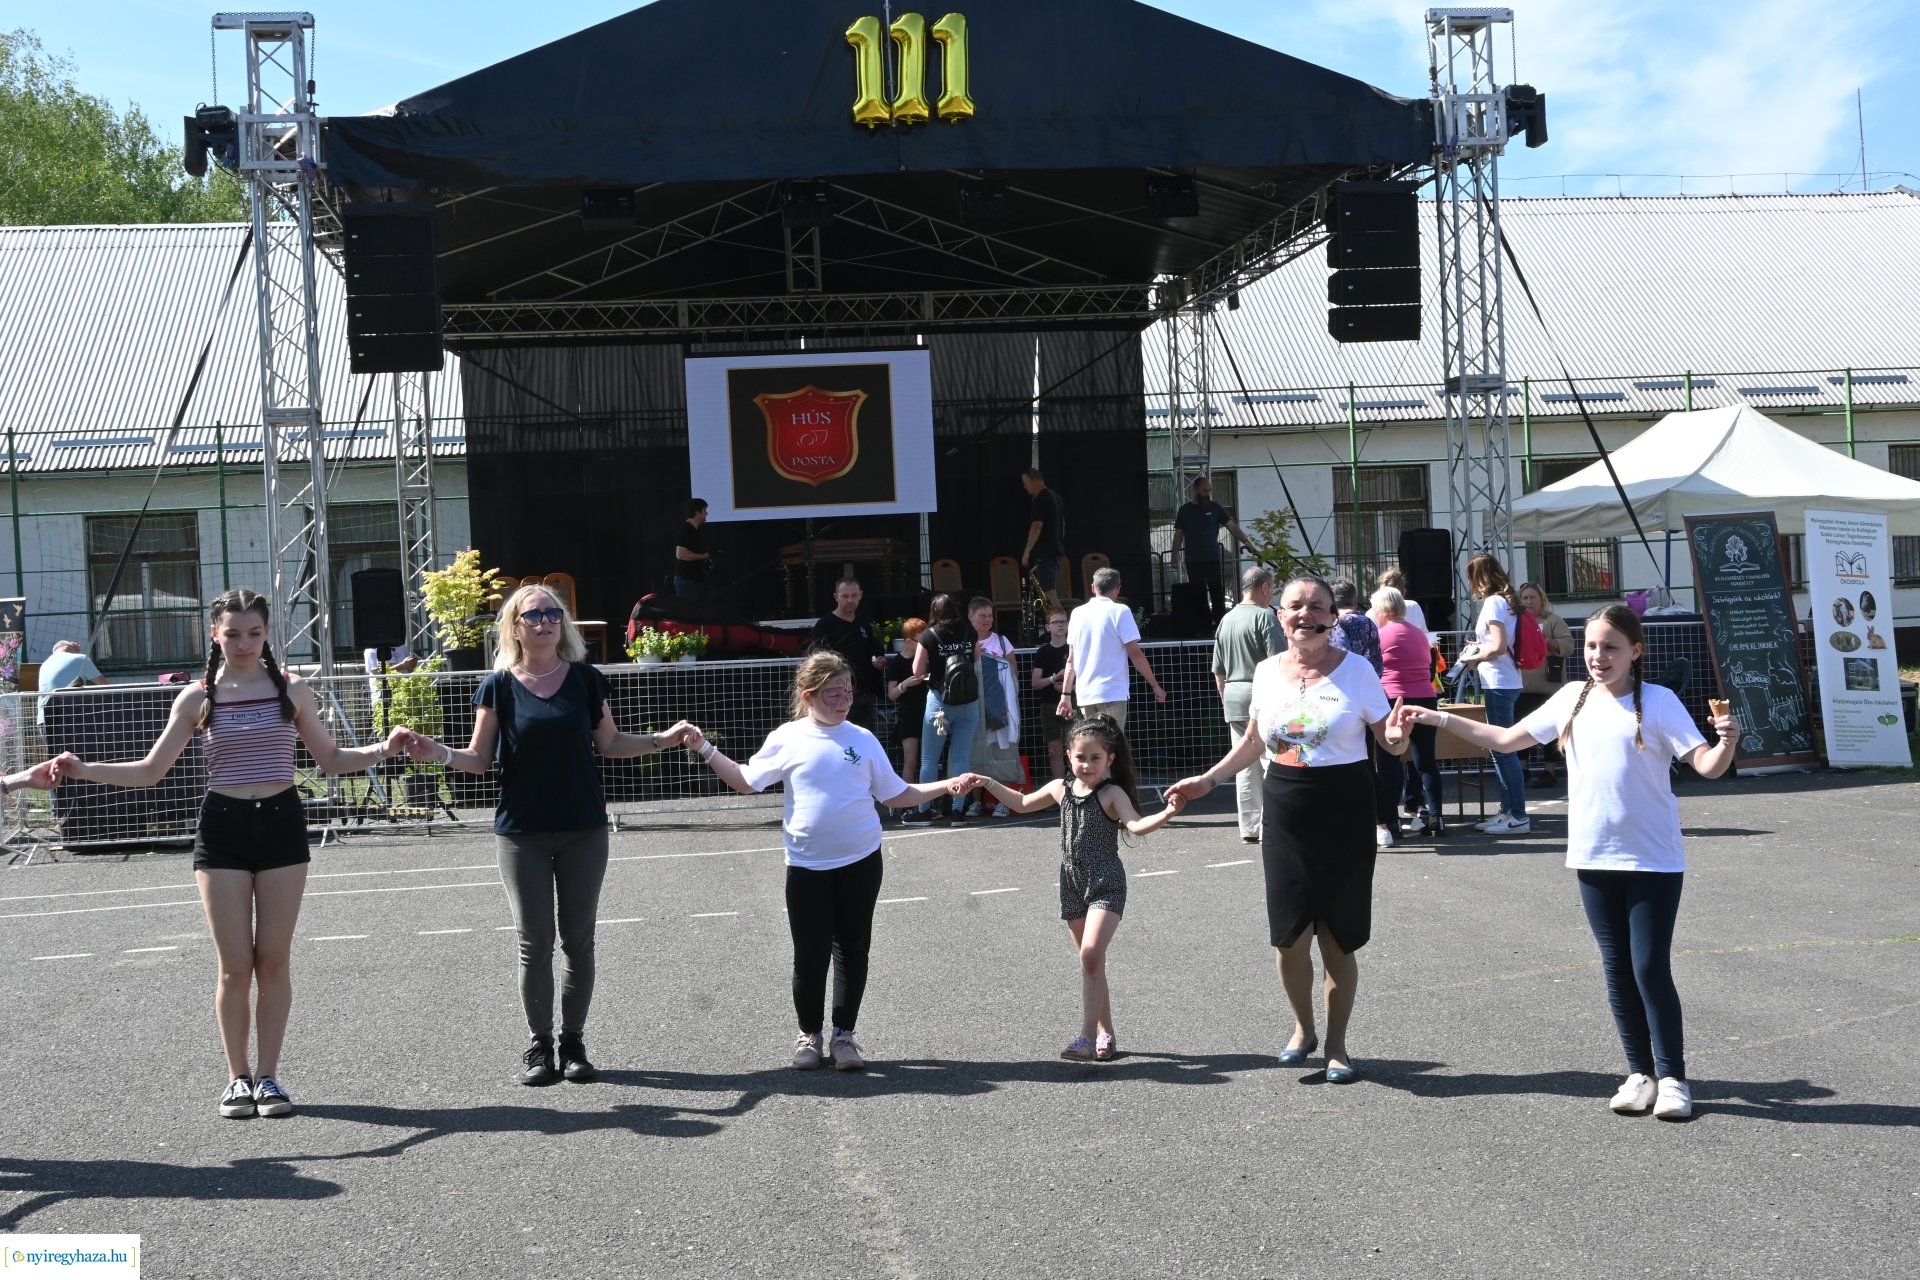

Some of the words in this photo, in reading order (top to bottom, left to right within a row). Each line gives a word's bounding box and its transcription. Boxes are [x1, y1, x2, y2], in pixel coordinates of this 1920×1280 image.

[845, 12, 976, 128] 111
[791, 409, 831, 425] HÚS
[792, 456, 836, 466] POSTA
[1319, 695, 1339, 703] MONI
